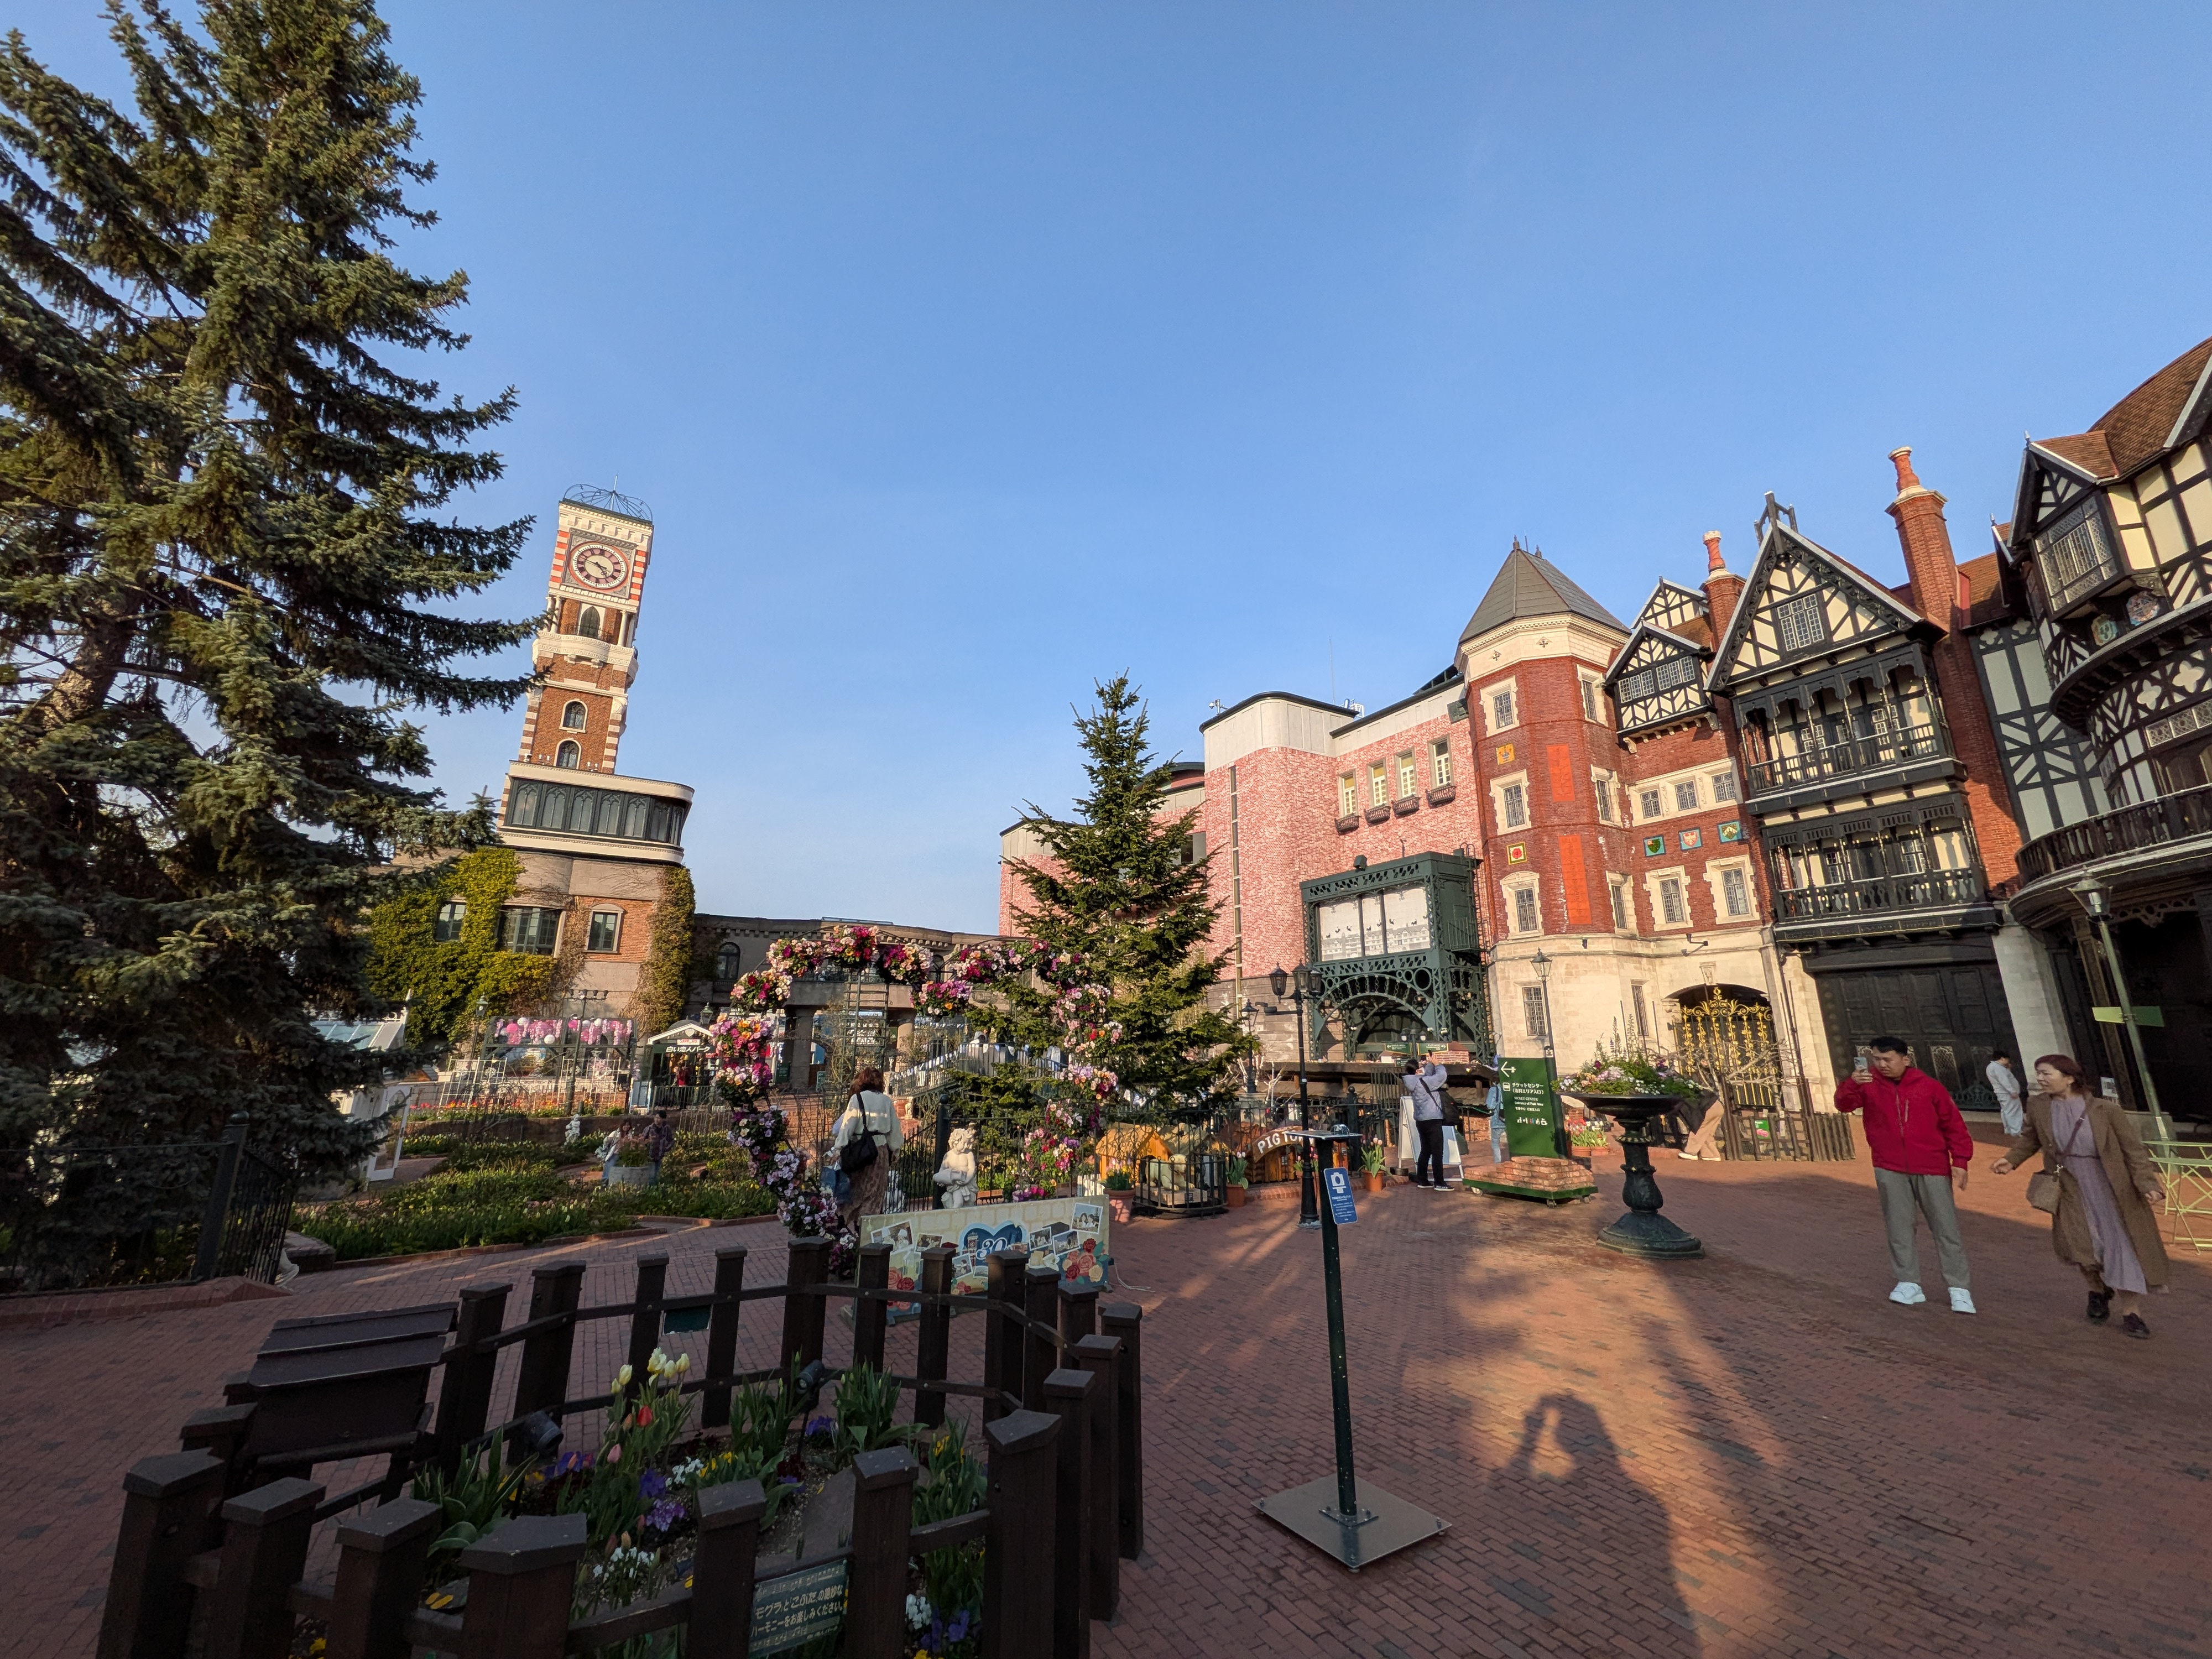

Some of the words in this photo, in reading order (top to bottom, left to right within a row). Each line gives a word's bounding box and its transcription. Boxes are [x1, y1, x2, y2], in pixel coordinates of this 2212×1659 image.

[1258, 1133, 1280, 1154] PIG
[1281, 1130, 1314, 1144] TO
[976, 1237, 1007, 1260] 30
[750, 1601, 843, 1637] ハーモニーをお楽しみください。
